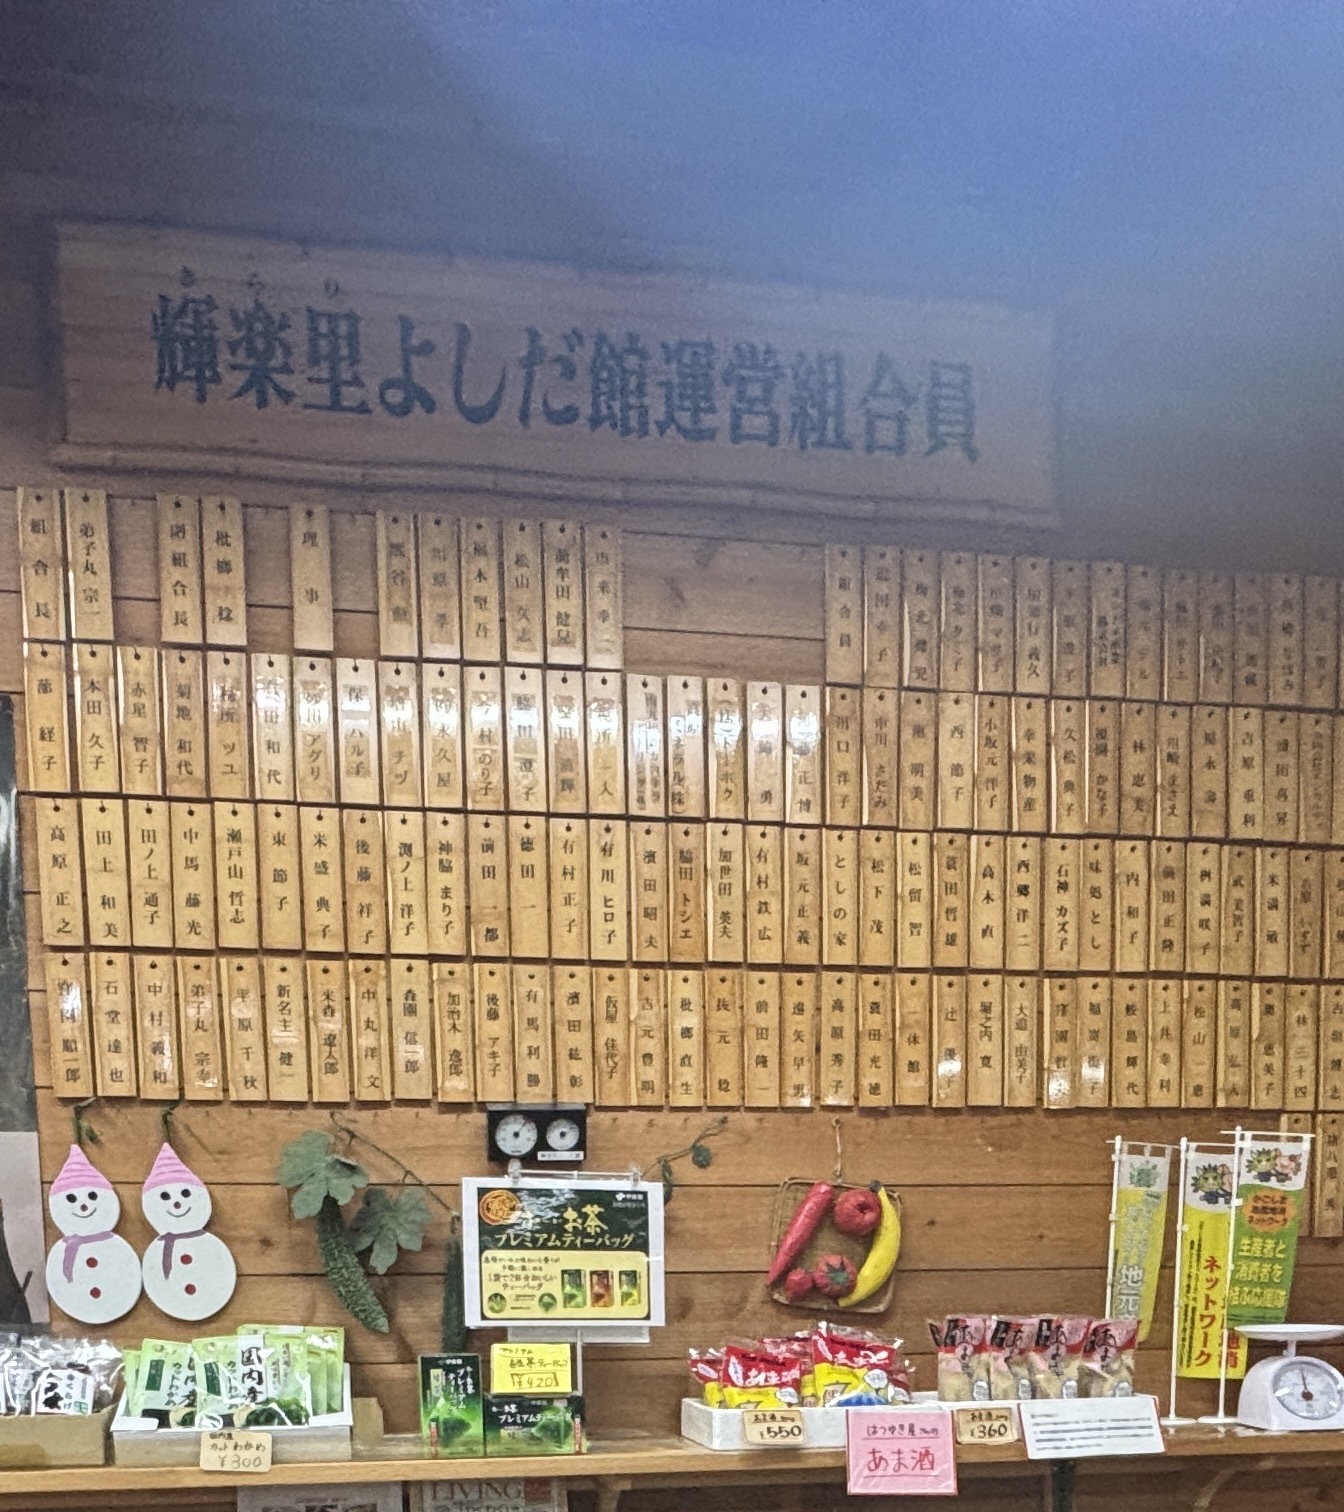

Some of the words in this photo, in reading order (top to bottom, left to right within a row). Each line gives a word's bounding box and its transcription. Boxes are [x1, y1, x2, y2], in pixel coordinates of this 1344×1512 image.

[150, 290, 979, 465] 輝楽里よしだ館運営組合員
[30, 518, 51, 619] 組合長
[51, 827, 72, 934] 高原正之
[96, 831, 118, 938] 田上和美
[833, 855, 847, 947] としの家
[495, 1232, 635, 1248] プレミアムティーバッグ
[1194, 1255, 1222, 1367] ネットワーク
[219, 1455, 262, 1468] ¥300
[866, 1449, 936, 1473] あま酒
